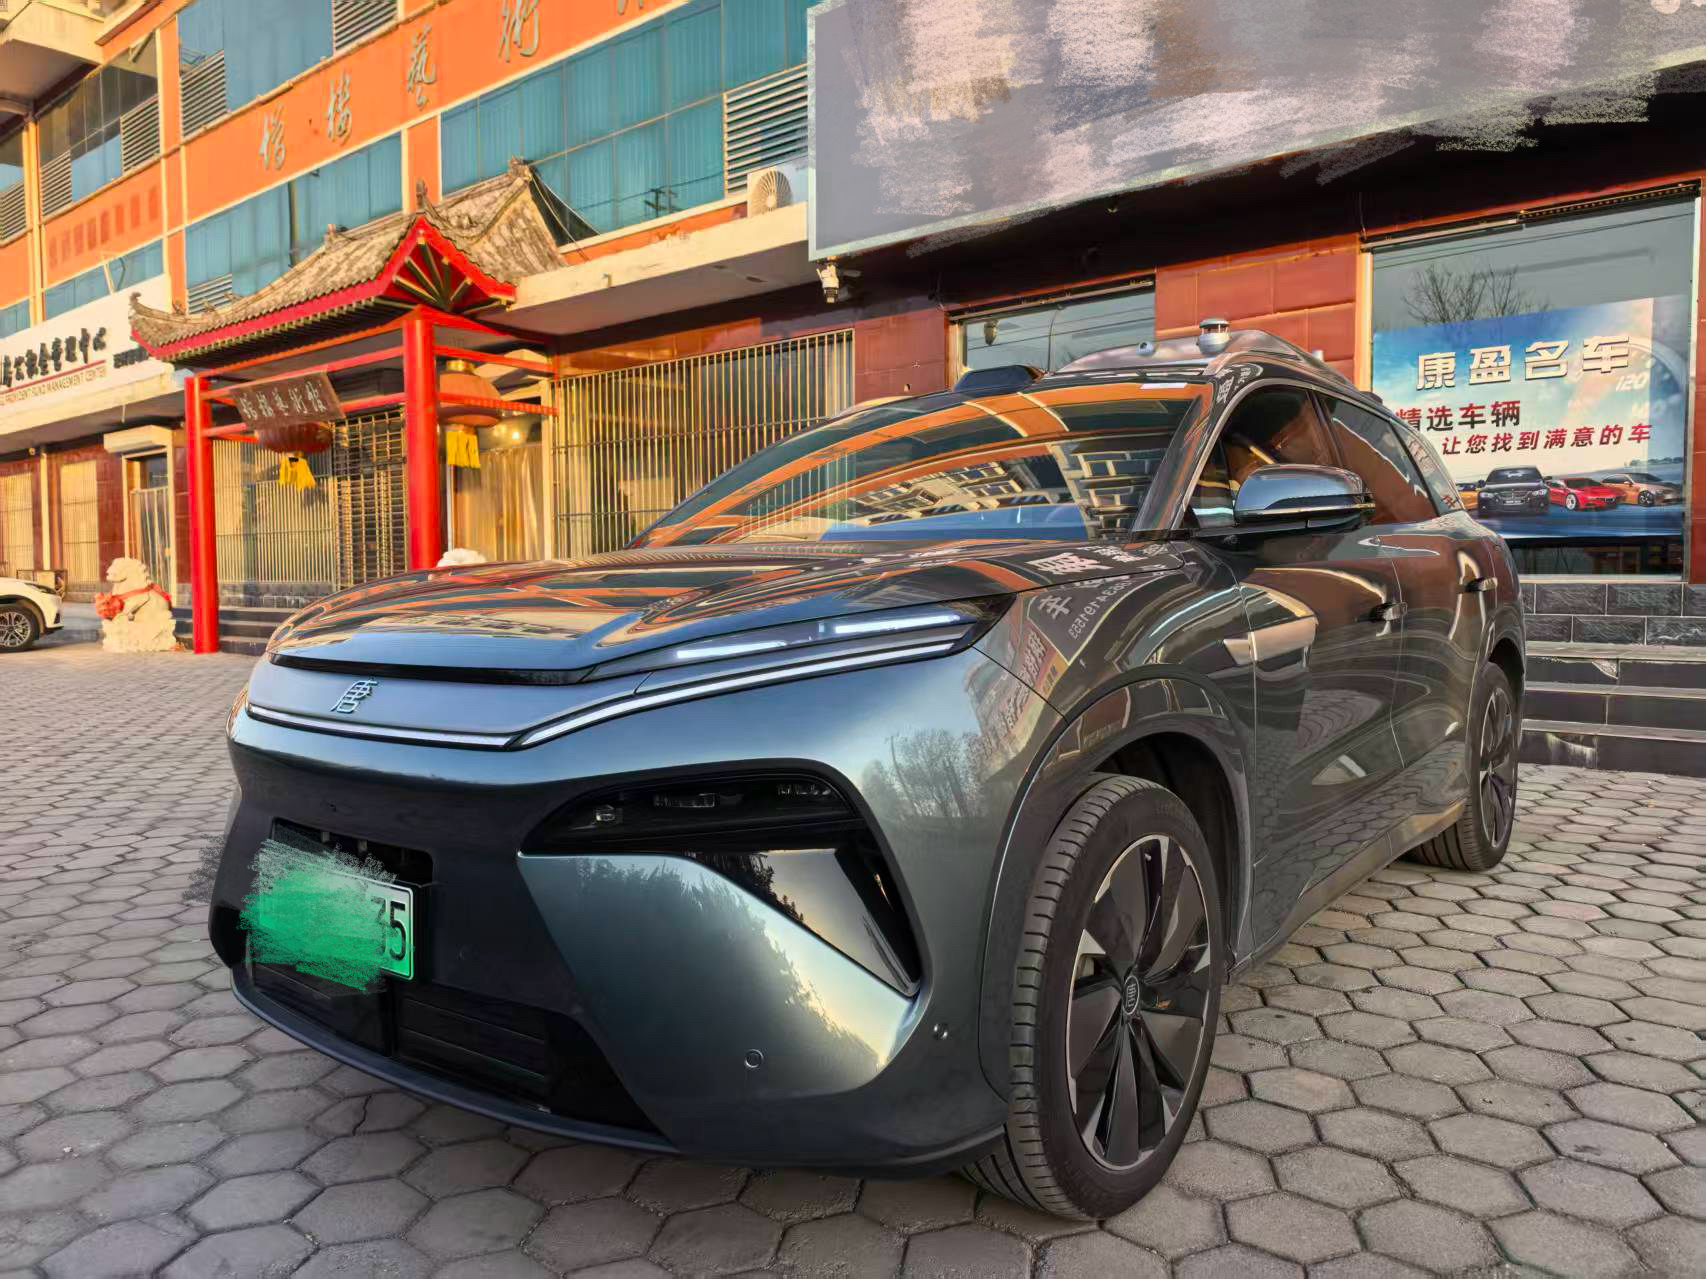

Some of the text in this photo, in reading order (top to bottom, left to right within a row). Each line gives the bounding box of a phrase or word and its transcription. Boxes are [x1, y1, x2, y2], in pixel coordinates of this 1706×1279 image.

[1416, 335, 1630, 391] 康盈名车
[1395, 400, 1520, 431] 精选车辆
[1442, 423, 1652, 455] 让您找到满意的车
[331, 677, 379, 714] 唐
